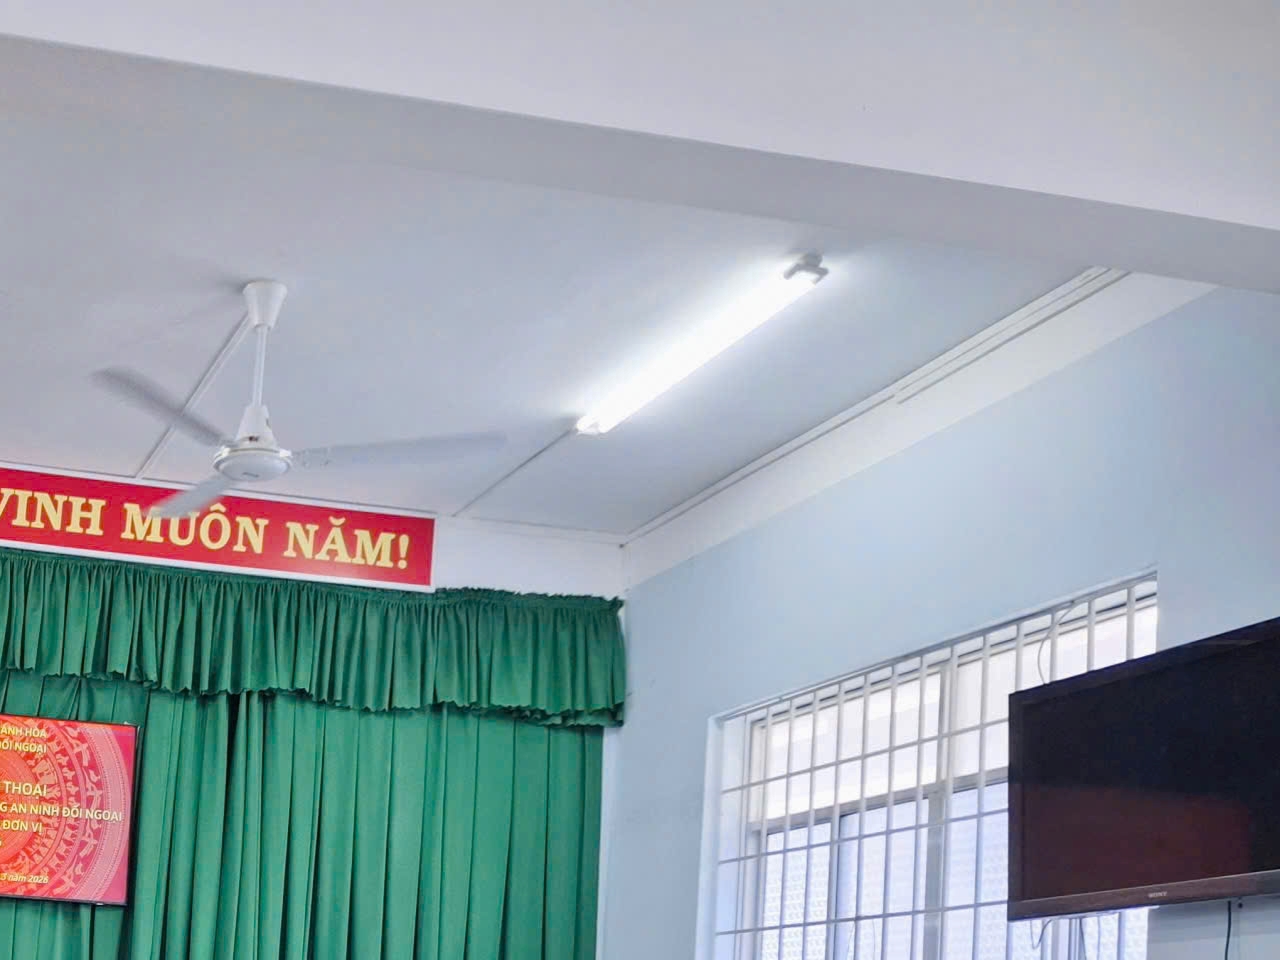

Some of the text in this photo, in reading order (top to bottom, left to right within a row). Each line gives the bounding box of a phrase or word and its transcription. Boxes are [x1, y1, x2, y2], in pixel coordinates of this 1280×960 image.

[120, 502, 269, 554] MUÔN
[283, 516, 410, 570] NĂM!
[14, 741, 47, 755] NGOẠI
[3, 780, 47, 800] THOẠI
[10, 803, 27, 814] AN
[29, 805, 59, 817] NINH
[62, 804, 83, 818] ĐỐI
[85, 809, 122, 824] NGOẠI
[2, 819, 29, 832] ĐƠN
[32, 822, 43, 835] VỊ
